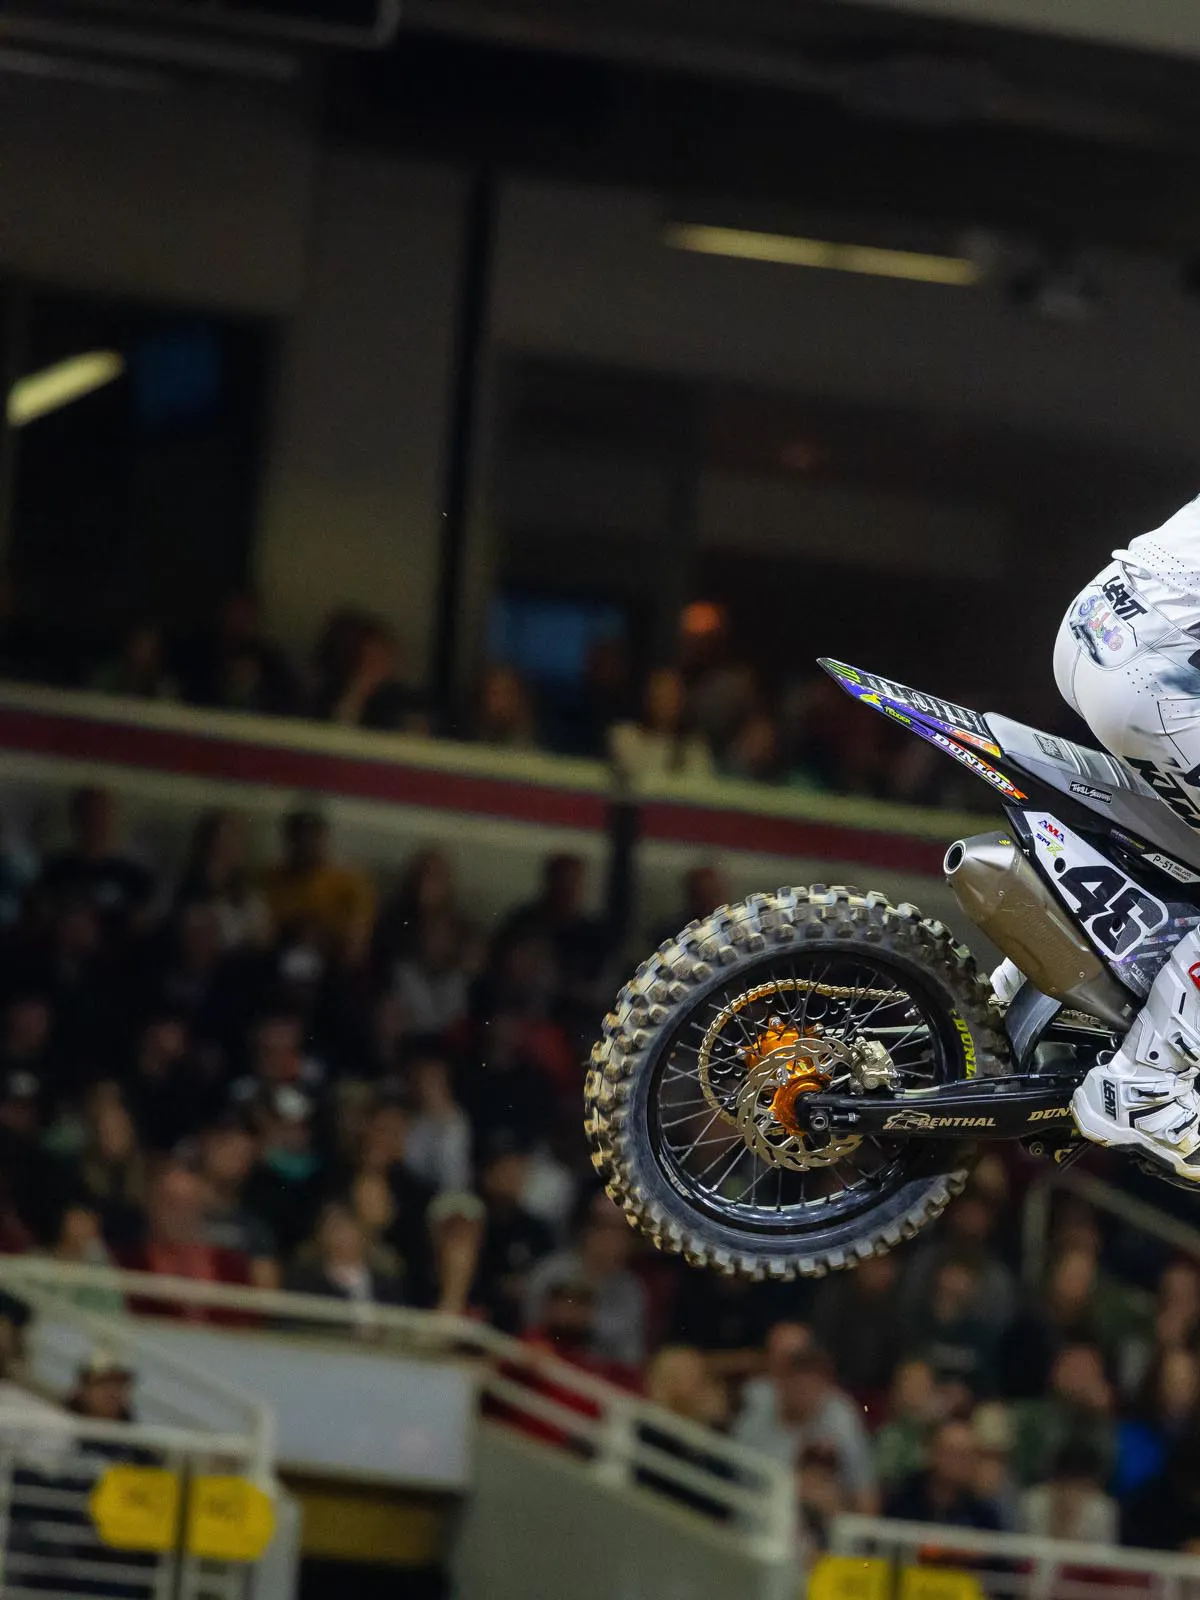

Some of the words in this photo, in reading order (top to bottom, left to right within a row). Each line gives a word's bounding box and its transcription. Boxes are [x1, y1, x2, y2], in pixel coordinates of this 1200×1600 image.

[1102, 576, 1148, 621] LEATT
[933, 733, 1015, 791] DUNLOP
[1037, 820, 1064, 845] AMA
[1153, 855, 1174, 871] P-51
[1058, 866, 1164, 957] 46
[1102, 1079, 1117, 1121] LEATT
[916, 1117, 997, 1128] RENTHAL
